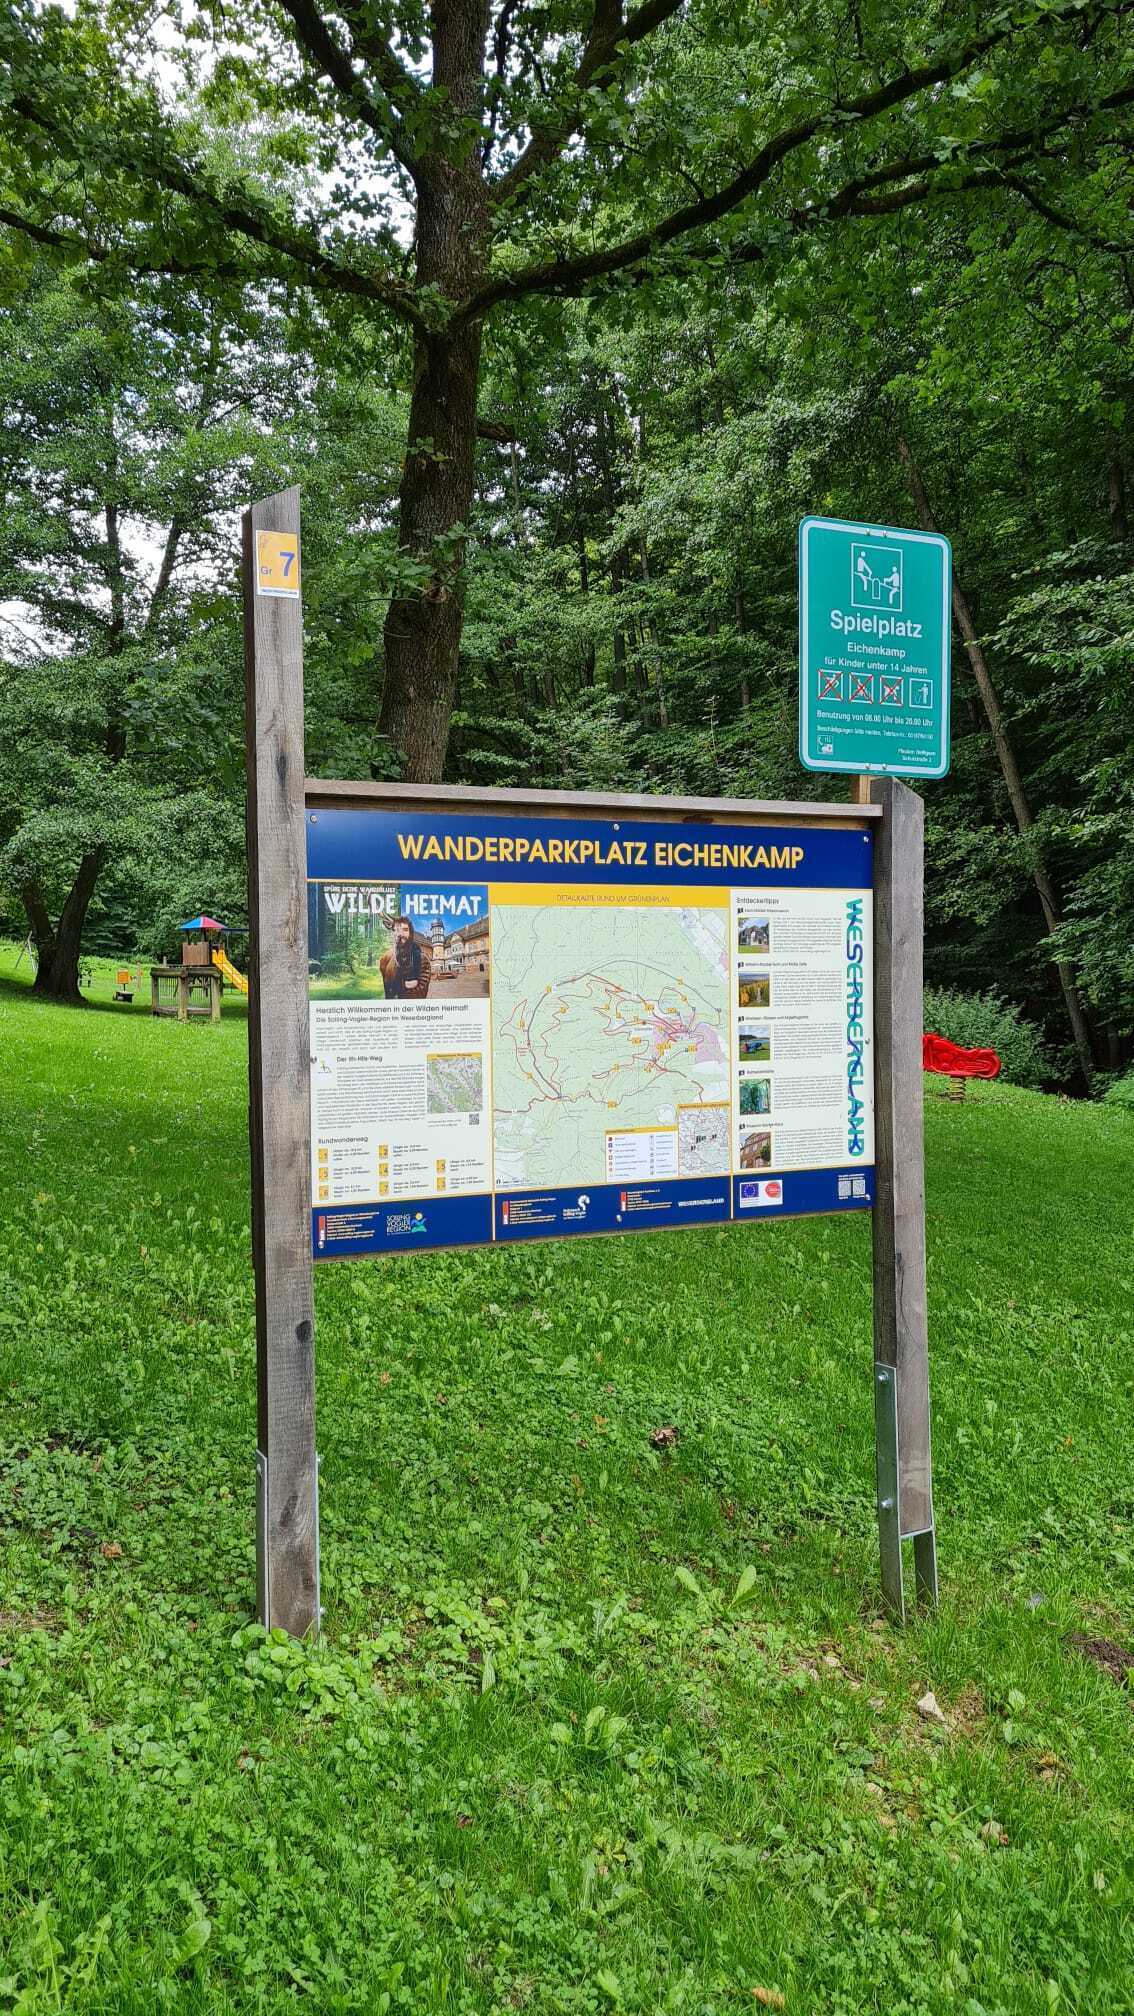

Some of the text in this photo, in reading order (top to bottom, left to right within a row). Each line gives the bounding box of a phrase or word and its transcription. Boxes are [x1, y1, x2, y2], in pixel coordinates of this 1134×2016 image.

[279, 551, 295, 577] 7
[830, 609, 923, 639] Spielplatz
[847, 641, 906, 659] Eichenkamp
[824, 656, 928, 675] für Kinder unter 14 Jahren
[816, 709, 851, 722] Benutzung
[882, 715, 893, 724] Uhr
[894, 716, 904, 724] bis
[922, 718, 933, 727] Uhr
[397, 834, 804, 869] WANDERPARKPLATZ EICHENKAMP
[323, 892, 482, 916] WILDE HEIMAT
[316, 1006, 346, 1014] Herzlich
[347, 1005, 392, 1014] Willkommen
[402, 1005, 414, 1013] der
[416, 1004, 440, 1012] Wilden
[400, 1013, 444, 1023] Weserbergland
[846, 898, 864, 1157] WESERBERGLAND
